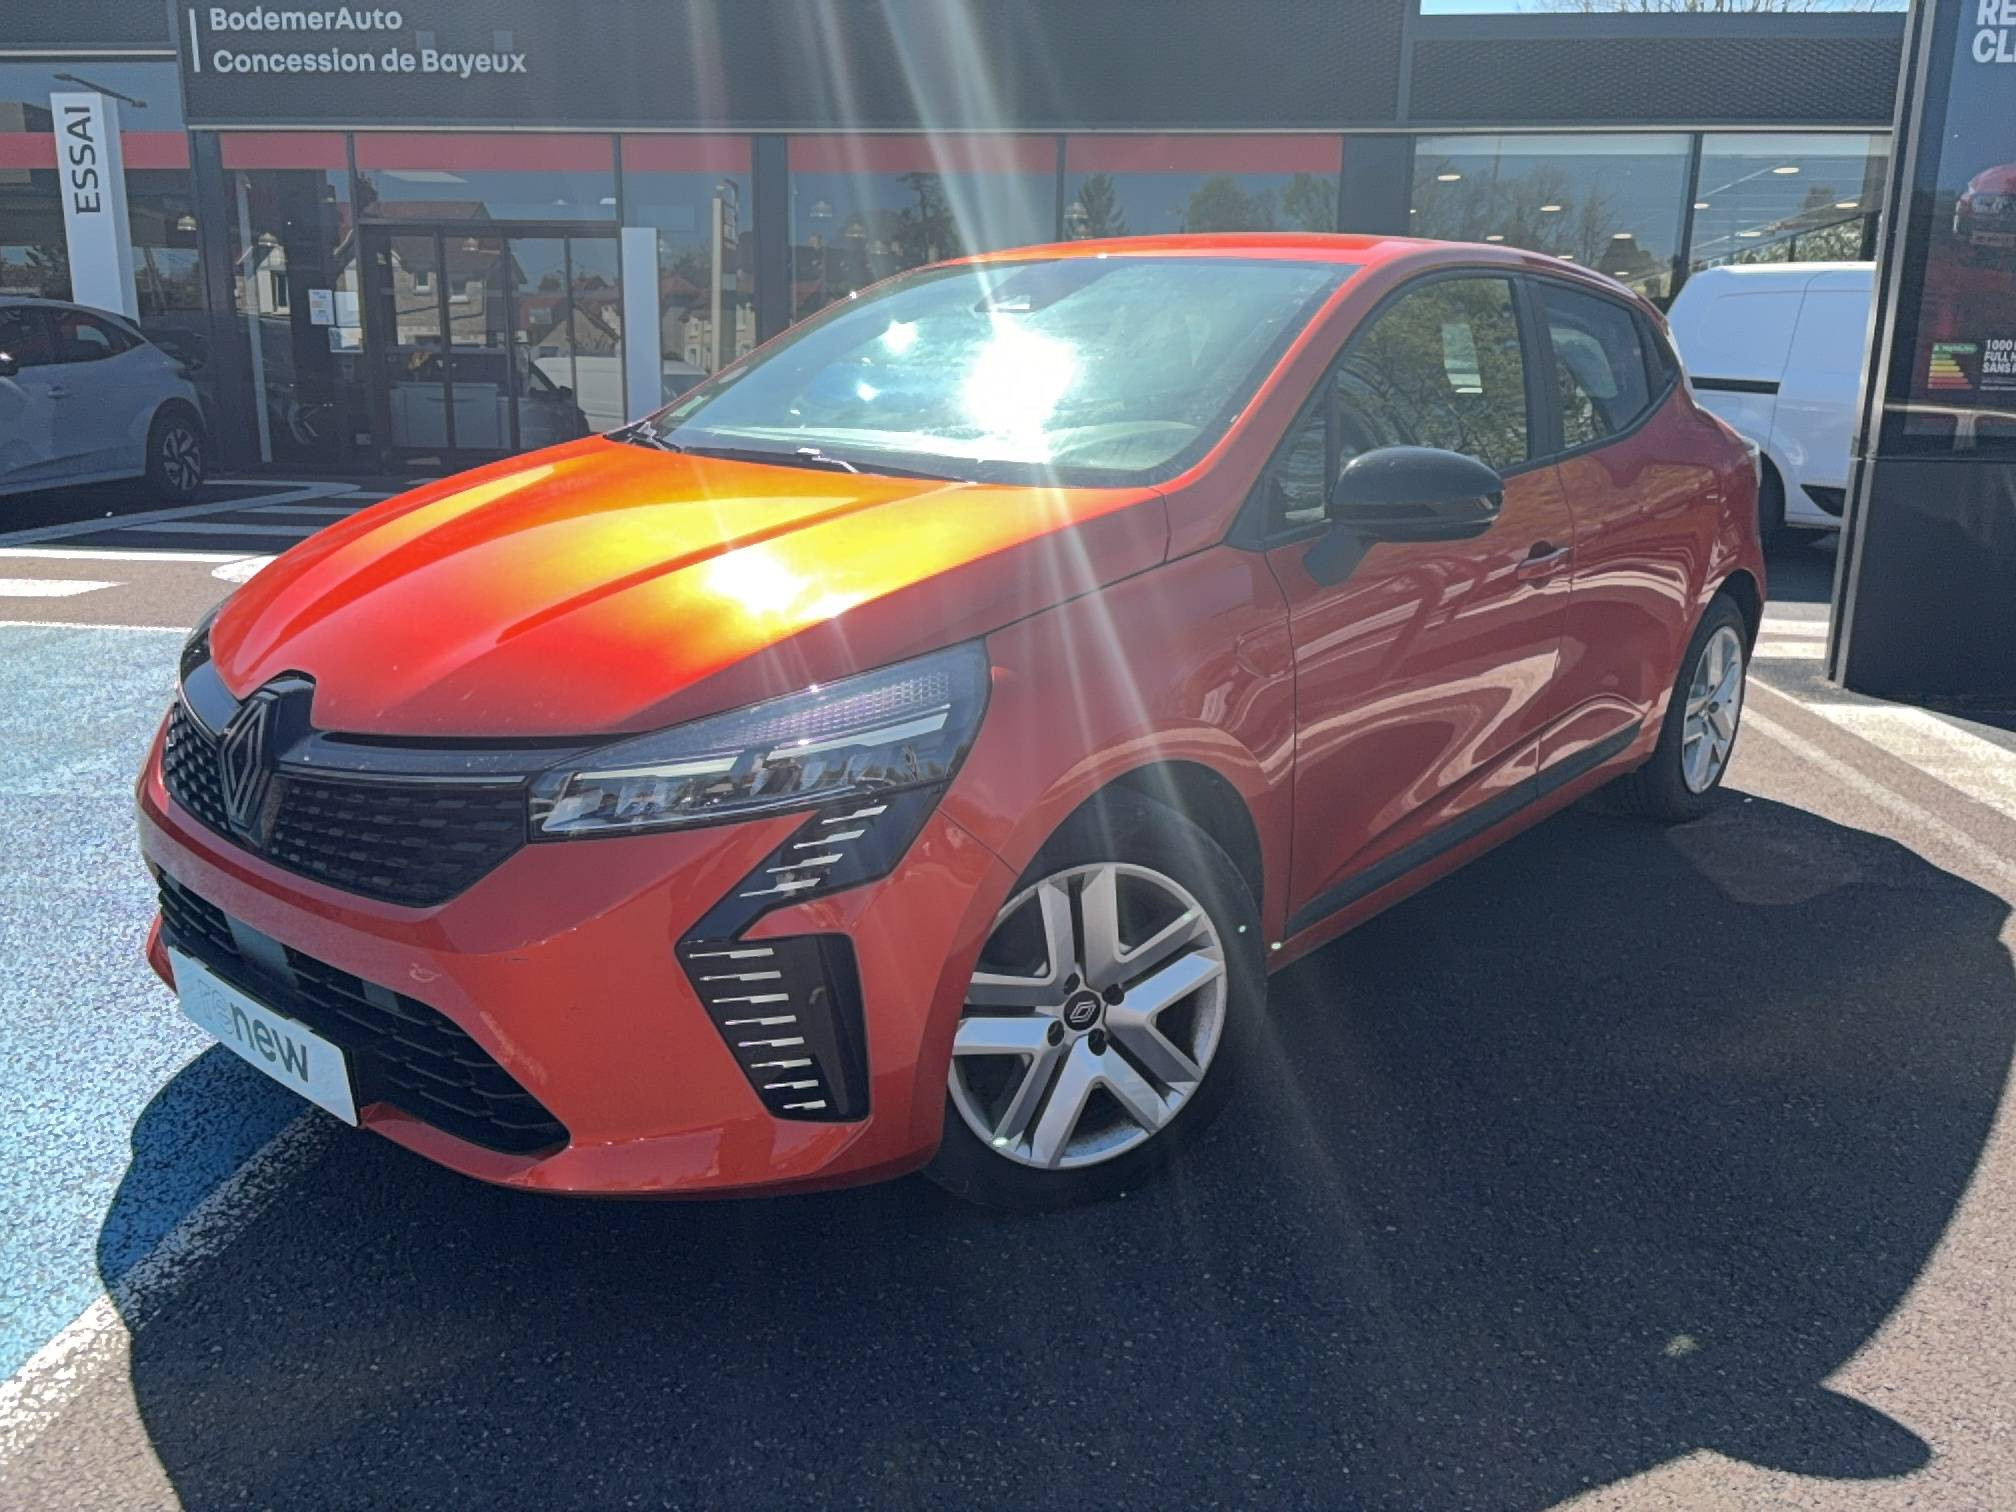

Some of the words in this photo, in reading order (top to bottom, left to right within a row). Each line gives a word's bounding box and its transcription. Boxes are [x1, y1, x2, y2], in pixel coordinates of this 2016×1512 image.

[210, 7, 403, 31] BodemerAuto
[1972, 29, 2016, 63] CL
[213, 48, 375, 73] Concession
[381, 48, 416, 72] de
[421, 48, 527, 79] Bayeux
[64, 106, 101, 214] ESSAI
